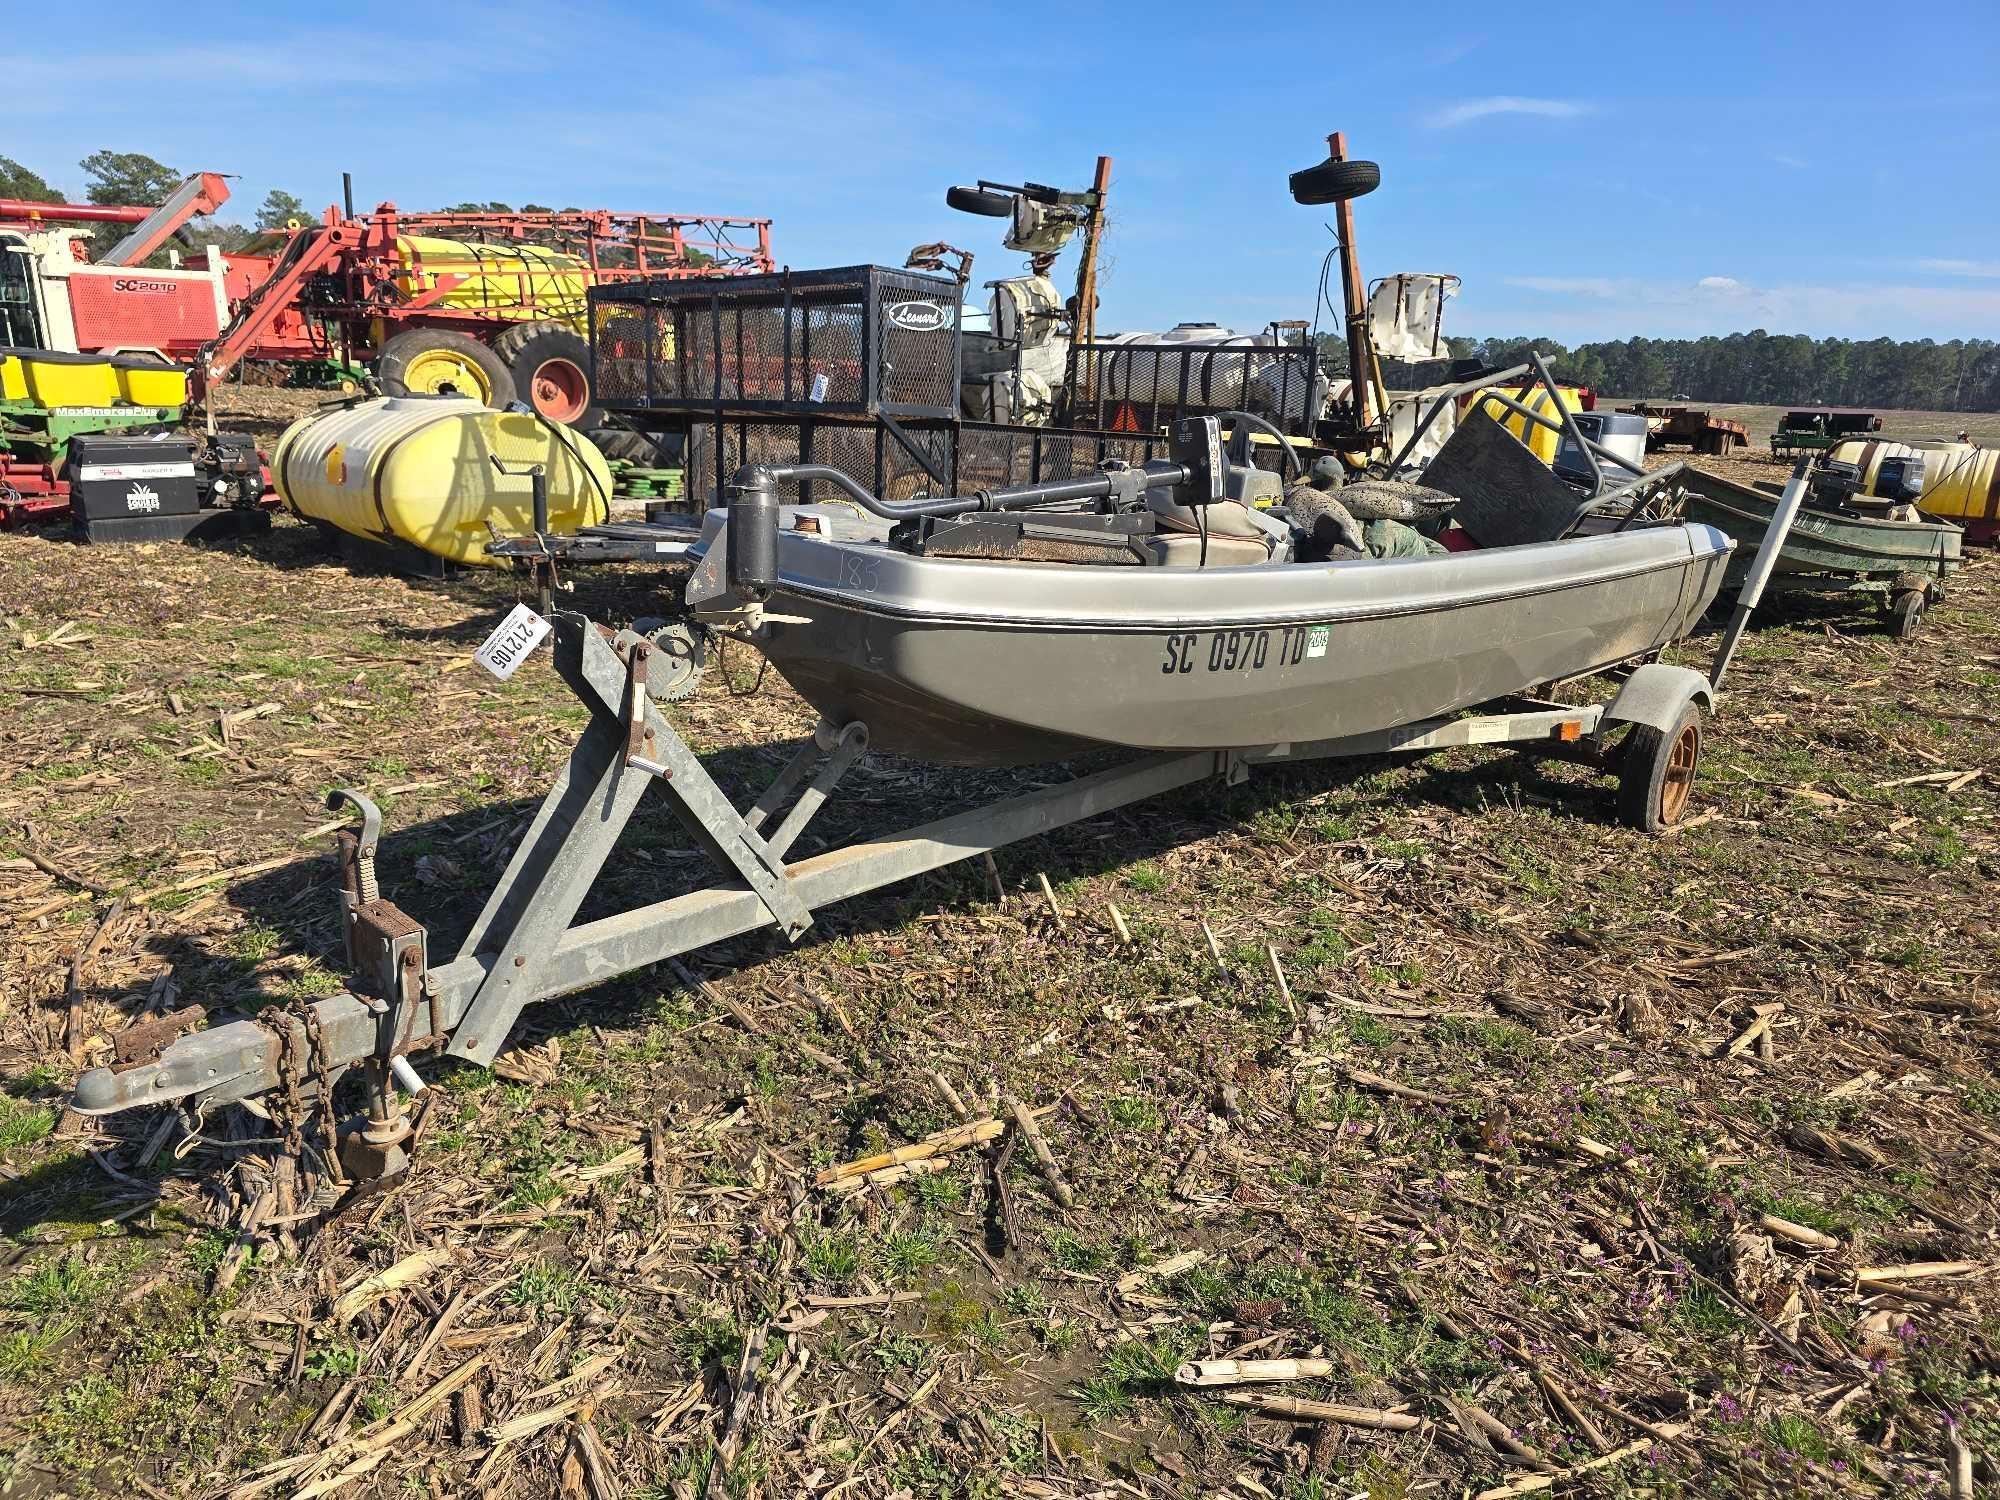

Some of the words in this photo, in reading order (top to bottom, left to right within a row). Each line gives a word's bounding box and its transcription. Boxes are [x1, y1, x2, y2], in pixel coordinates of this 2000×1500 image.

[896, 306, 939, 324] Leonard
[837, 552, 881, 593] 185
[490, 622, 534, 670] 212105
[1162, 634, 1198, 674] SC
[1207, 631, 1270, 672] 0970
[1280, 627, 1306, 666] TD
